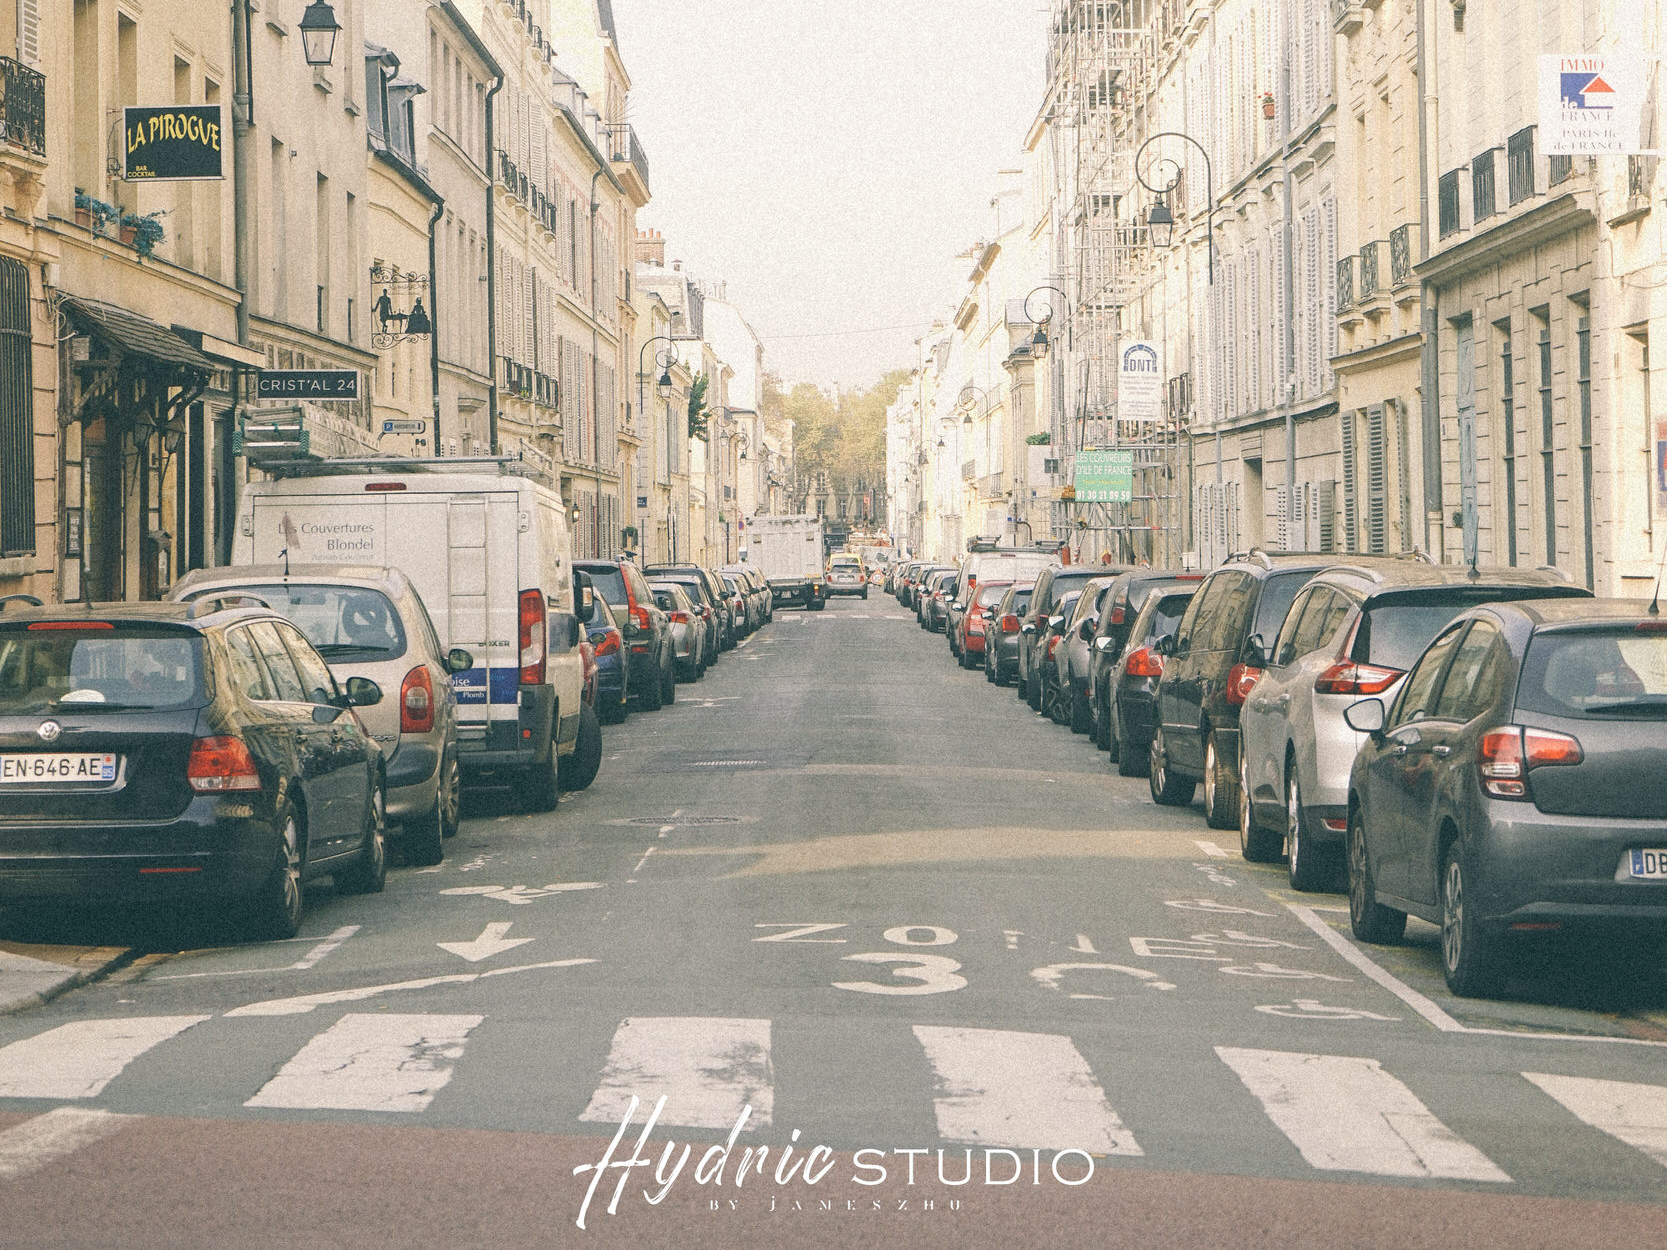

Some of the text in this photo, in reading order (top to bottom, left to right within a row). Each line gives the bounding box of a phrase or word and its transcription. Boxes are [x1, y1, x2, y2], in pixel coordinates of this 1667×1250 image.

[1561, 59, 1604, 71] IMMO
[1561, 96, 1578, 109] de
[1561, 111, 1614, 122] FRANCE
[127, 113, 220, 154] LA PIROGUE
[1563, 130, 1600, 139] PARIS
[1553, 141, 1623, 150] de FRANCE
[260, 379, 355, 391] CRIST'AL 24
[1076, 453, 1132, 463] LES COUVREURS
[1094, 465, 1103, 475] DE
[1104, 465, 1132, 476] FRANCE
[1076, 490, 1085, 500] 01
[278, 522, 375, 535] Ls Couvertures
[327, 537, 374, 550] Blondel
